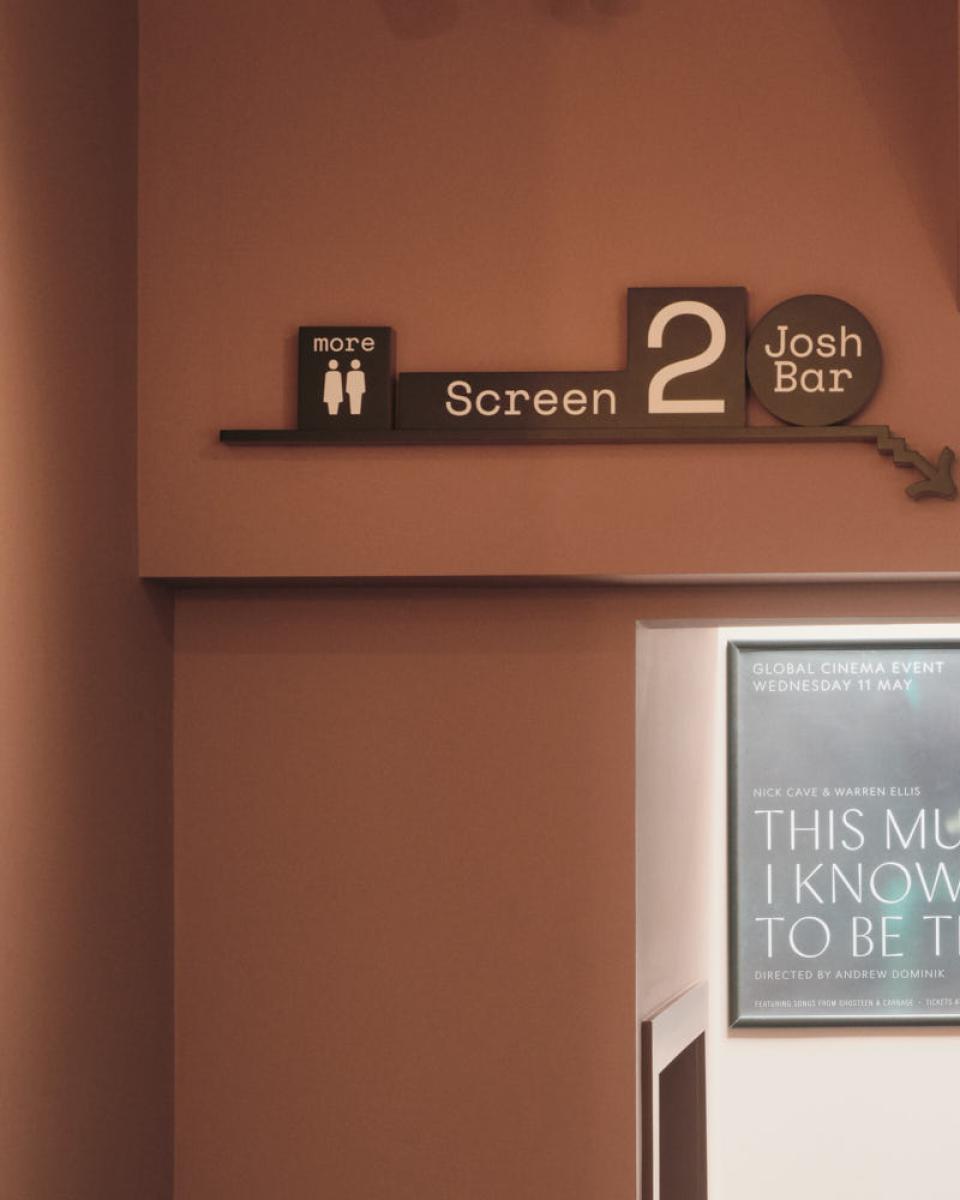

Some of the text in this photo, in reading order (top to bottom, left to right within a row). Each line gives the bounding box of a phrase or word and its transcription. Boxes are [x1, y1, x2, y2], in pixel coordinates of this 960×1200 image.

[313, 335, 375, 353] more
[765, 326, 862, 358] Josh
[445, 301, 726, 416] Screen 2
[773, 361, 853, 393] Bar
[752, 661, 944, 675] GLOBAL CINEMA EVENT
[753, 678, 913, 692] WEDNESDAY 11 MAY
[753, 786, 921, 798] NICK CAVE & WARREN ELLIS
[754, 808, 865, 851] THIS
[767, 863, 773, 905] I
[755, 916, 831, 959] TO
[852, 916, 904, 958] BE
[754, 969, 945, 980] DIRECTED BY ANDREW DOMINIK
